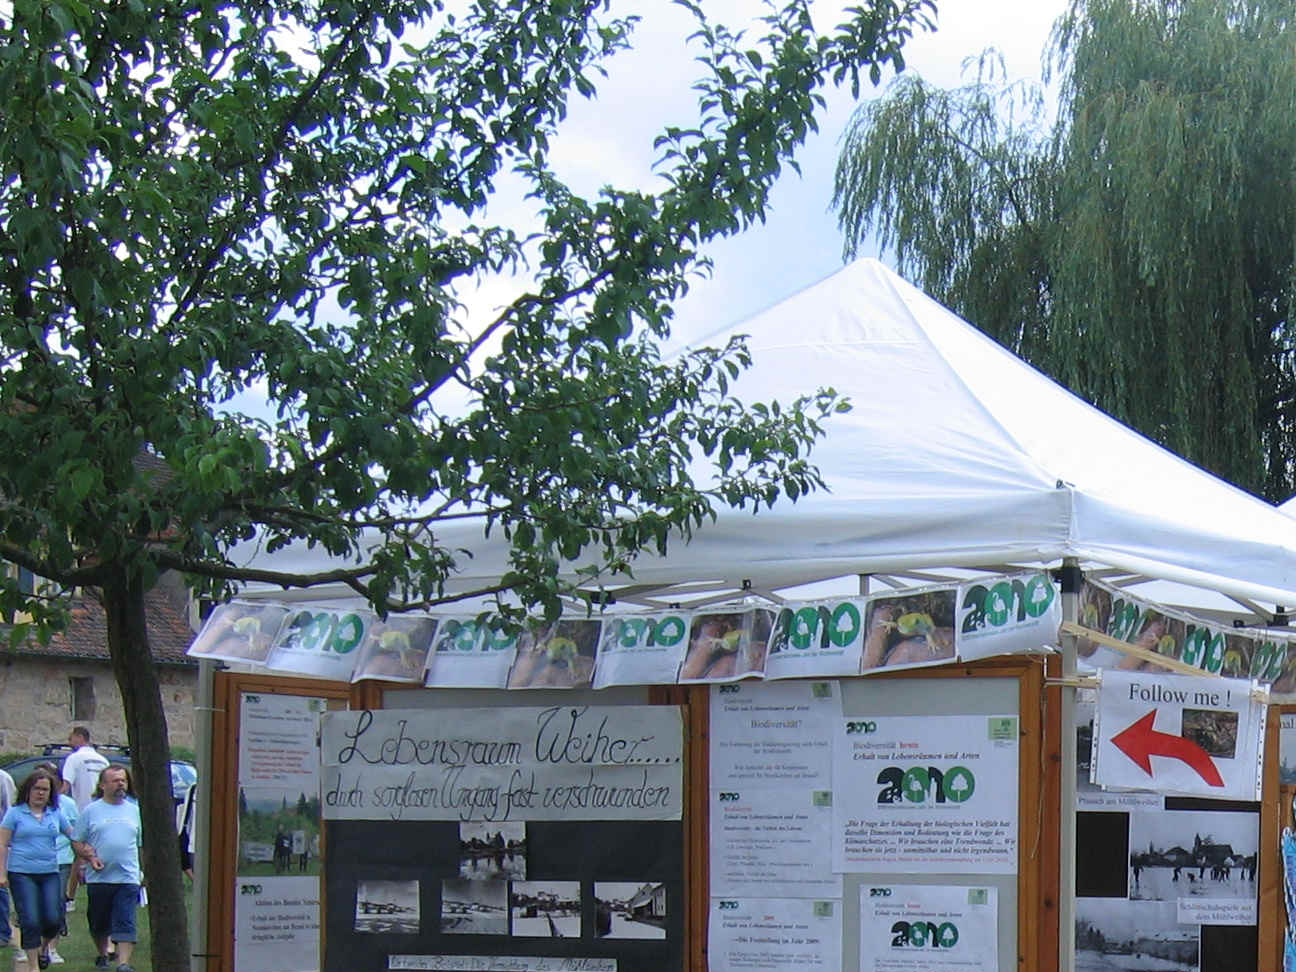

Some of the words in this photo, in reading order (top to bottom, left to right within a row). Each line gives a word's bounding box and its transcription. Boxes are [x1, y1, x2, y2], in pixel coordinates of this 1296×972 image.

[961, 574, 1055, 632] 2010
[279, 611, 364, 654] 2010
[601, 616, 686, 651] 2010
[769, 602, 861, 653] 2010
[1129, 683, 1188, 705] Follow
[1194, 693, 1219, 706] me
[1226, 690, 1232, 707] !
[338, 710, 522, 766] Lebensraum
[751, 720, 802, 729] Biodiversität?
[846, 722, 877, 734] 2010
[853, 752, 875, 761] Erhalt
[878, 752, 889, 761] von
[891, 752, 942, 761] Lebensräumen
[944, 752, 958, 761] und
[960, 752, 980, 761] Arten
[502, 769, 539, 822] fast
[719, 792, 740, 801] 2010
[877, 766, 976, 804] 2010
[870, 888, 892, 897] 2010
[891, 921, 959, 948] 2010
